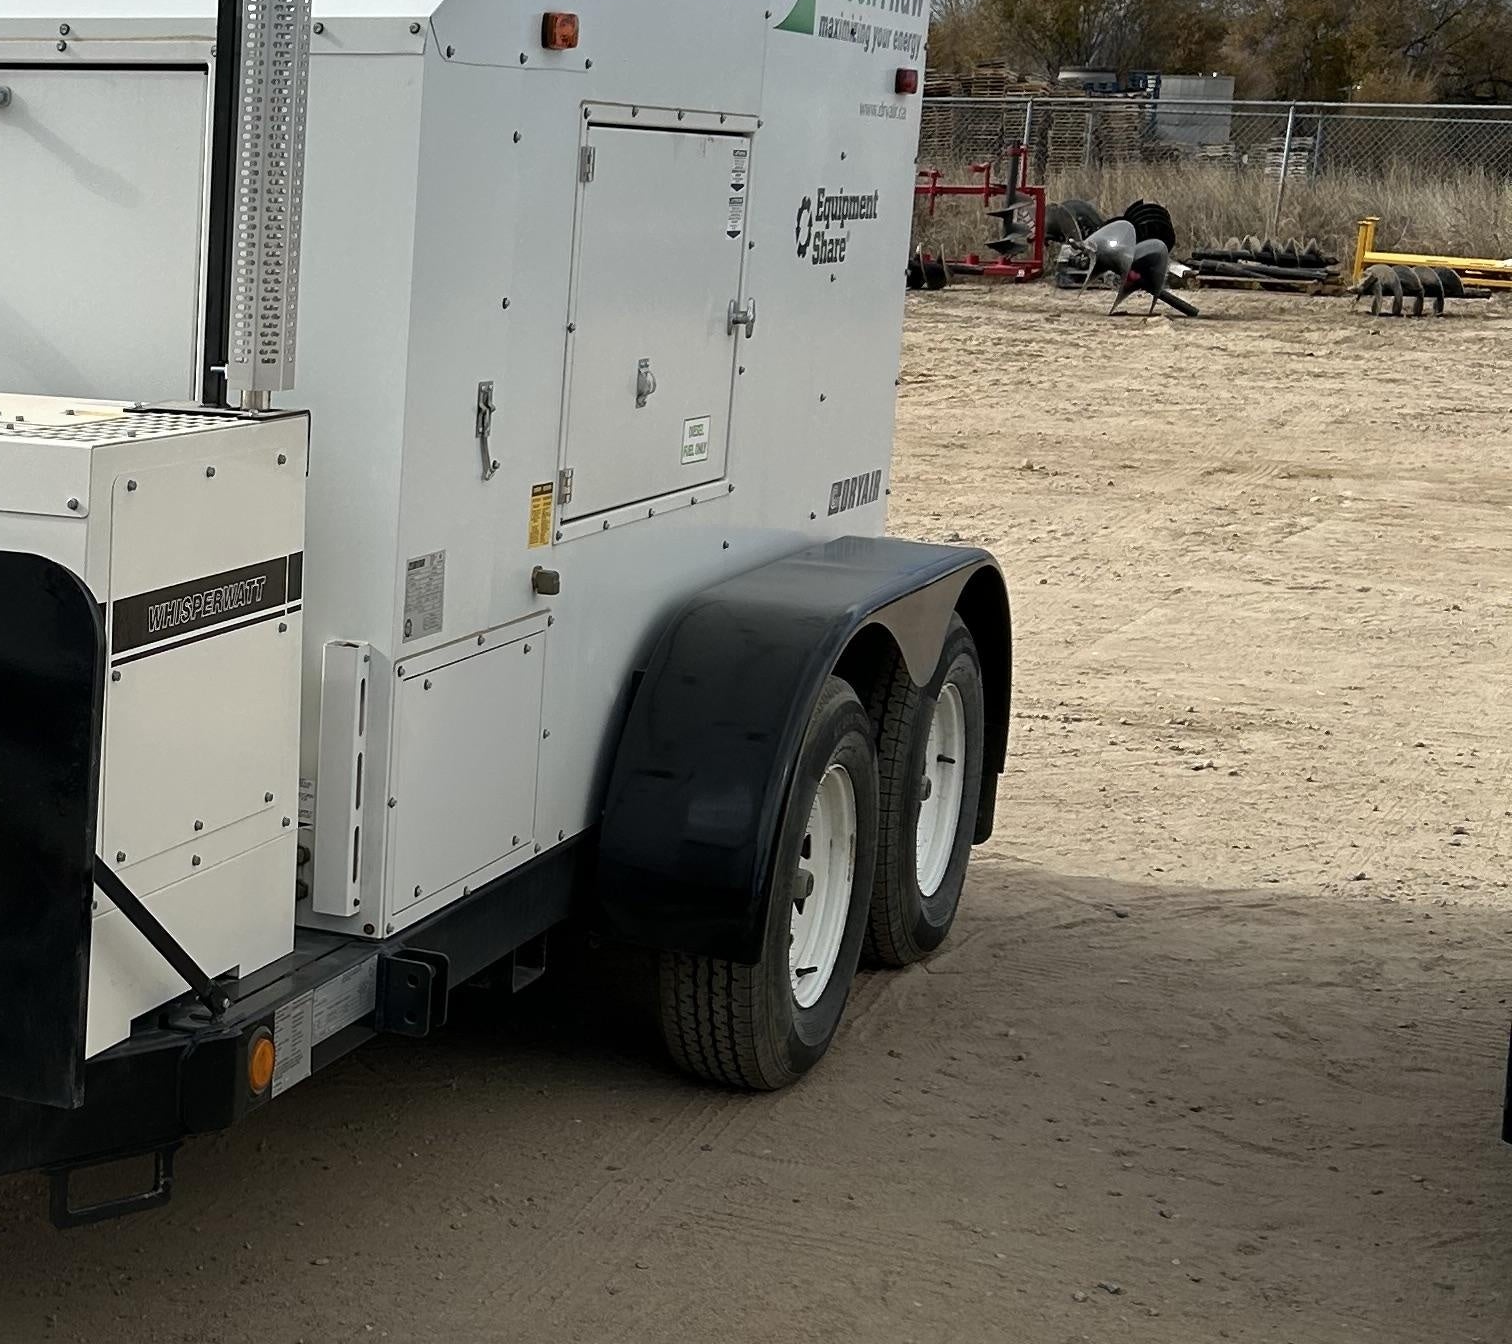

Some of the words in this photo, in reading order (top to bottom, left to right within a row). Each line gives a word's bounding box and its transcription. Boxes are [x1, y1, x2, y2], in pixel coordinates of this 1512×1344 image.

[818, 11, 872, 53] maximizing
[871, 25, 893, 54] your
[892, 30, 922, 61] energy
[815, 187, 879, 229] Equipment
[811, 231, 846, 265] Share
[148, 576, 266, 632] WHISPERWATT
